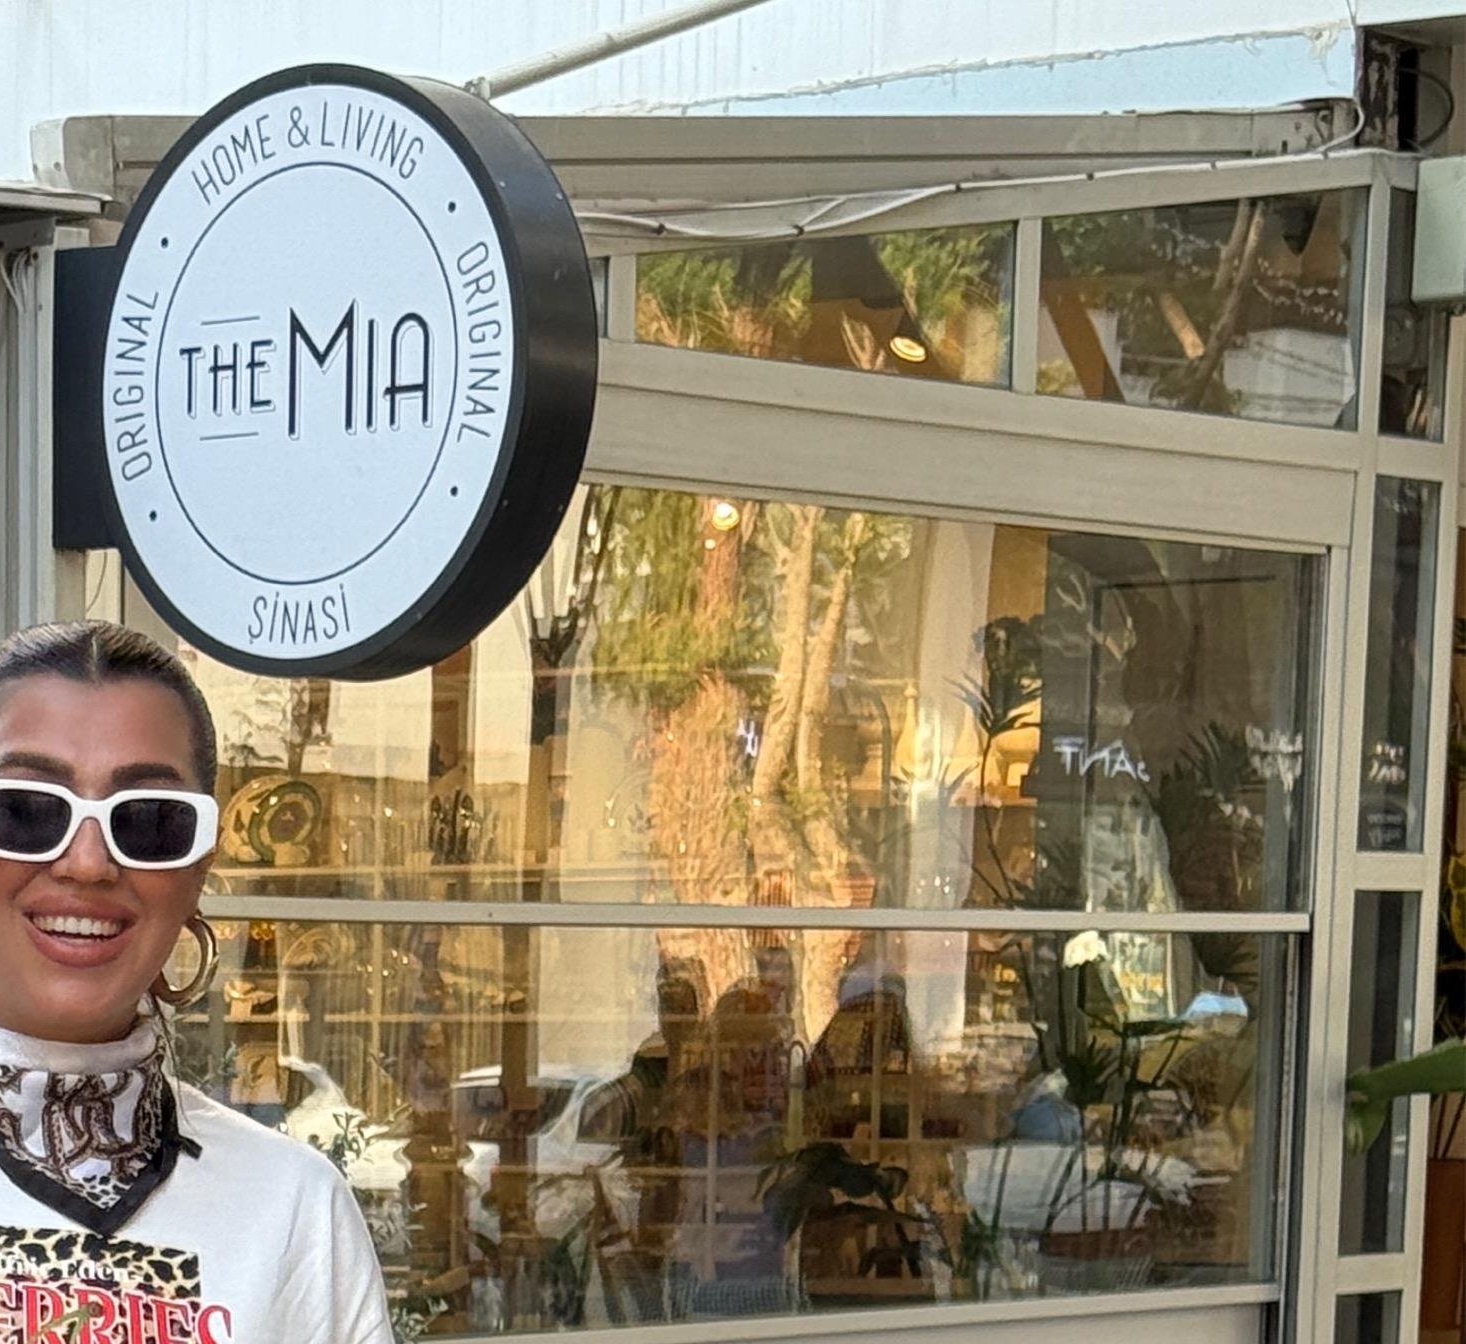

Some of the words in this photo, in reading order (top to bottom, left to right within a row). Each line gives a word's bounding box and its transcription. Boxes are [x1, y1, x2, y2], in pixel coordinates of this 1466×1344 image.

[191, 113, 276, 205] HOME
[287, 105, 311, 148] &
[320, 100, 426, 181] LIVING
[112, 289, 160, 482] ORIGINAL
[456, 240, 502, 445] ORIGINAL
[247, 583, 352, 645] ŞİNASİ
